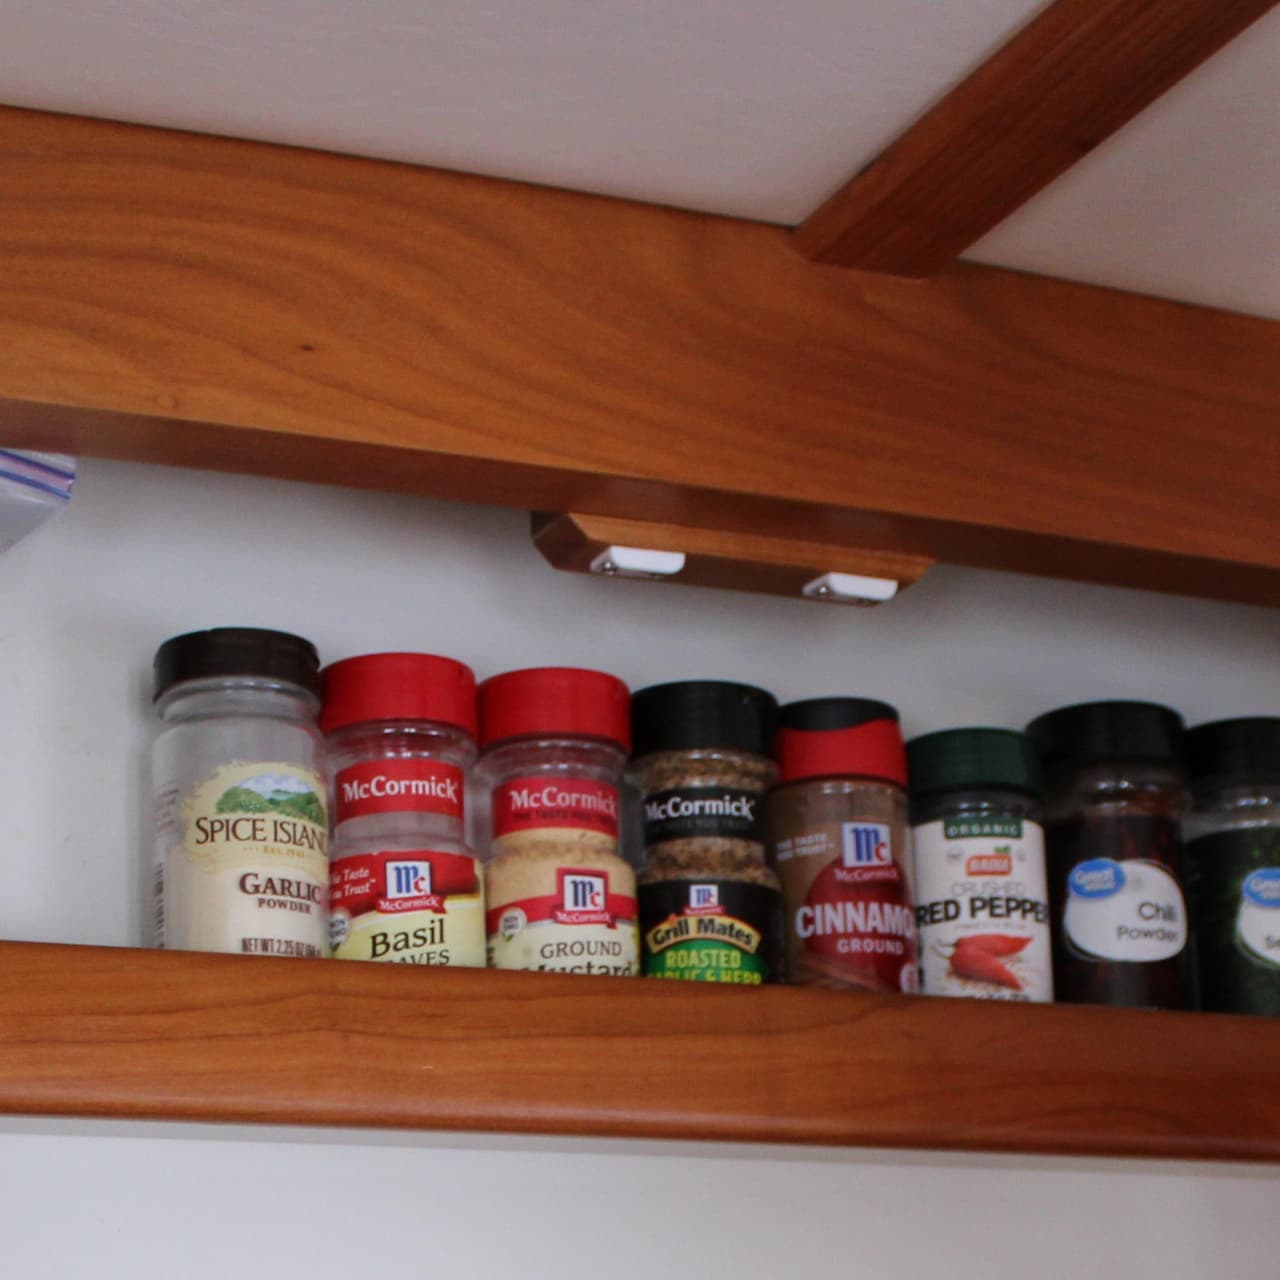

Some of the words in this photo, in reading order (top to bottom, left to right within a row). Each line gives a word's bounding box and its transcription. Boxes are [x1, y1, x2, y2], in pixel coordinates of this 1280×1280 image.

[343, 776, 458, 804] McCormick
[509, 786, 617, 818] McCormick
[645, 795, 754, 821] McCormick
[195, 815, 268, 845] SPICE
[946, 823, 1018, 837] ORGANIC
[258, 897, 313, 915] POWDER
[378, 896, 439, 911] McCormick
[916, 898, 961, 928] RED
[369, 917, 446, 960] Basil
[653, 918, 690, 945] Grill
[697, 916, 754, 945] Mates
[540, 940, 624, 960] GROUND
[665, 950, 742, 969] ROASTED
[837, 938, 905, 956] GROUND
